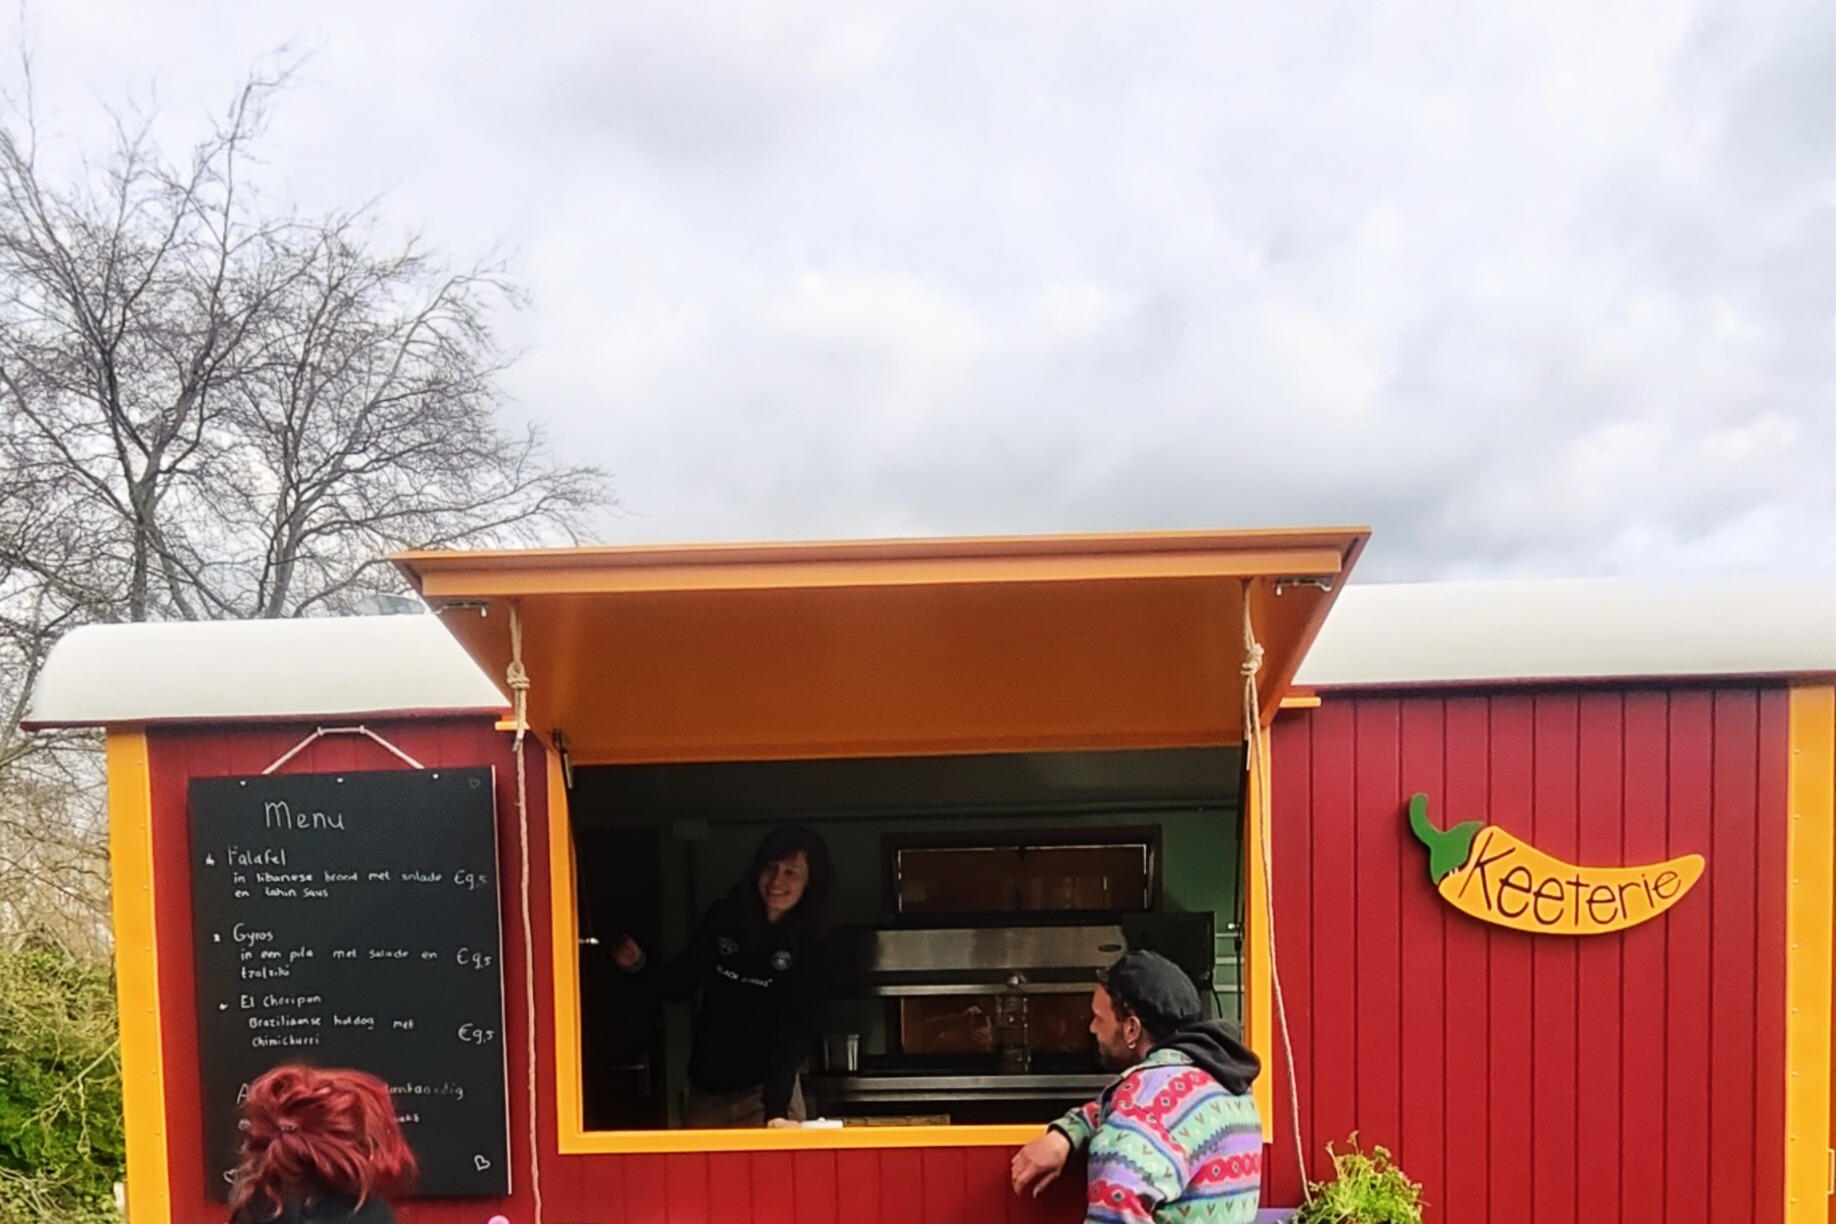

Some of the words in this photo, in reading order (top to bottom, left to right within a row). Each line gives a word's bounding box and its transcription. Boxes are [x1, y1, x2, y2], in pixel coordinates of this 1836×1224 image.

[264, 800, 345, 830] Menu
[227, 846, 286, 866] Falafel
[233, 872, 246, 883] in
[1458, 831, 1682, 927] Keeterie
[234, 889, 250, 898] en
[233, 923, 274, 947] Gyros
[240, 948, 252, 961] in
[260, 950, 281, 959] een
[332, 949, 357, 959] met
[421, 951, 438, 960] en
[241, 994, 255, 1008] El
[393, 1019, 415, 1030] met
